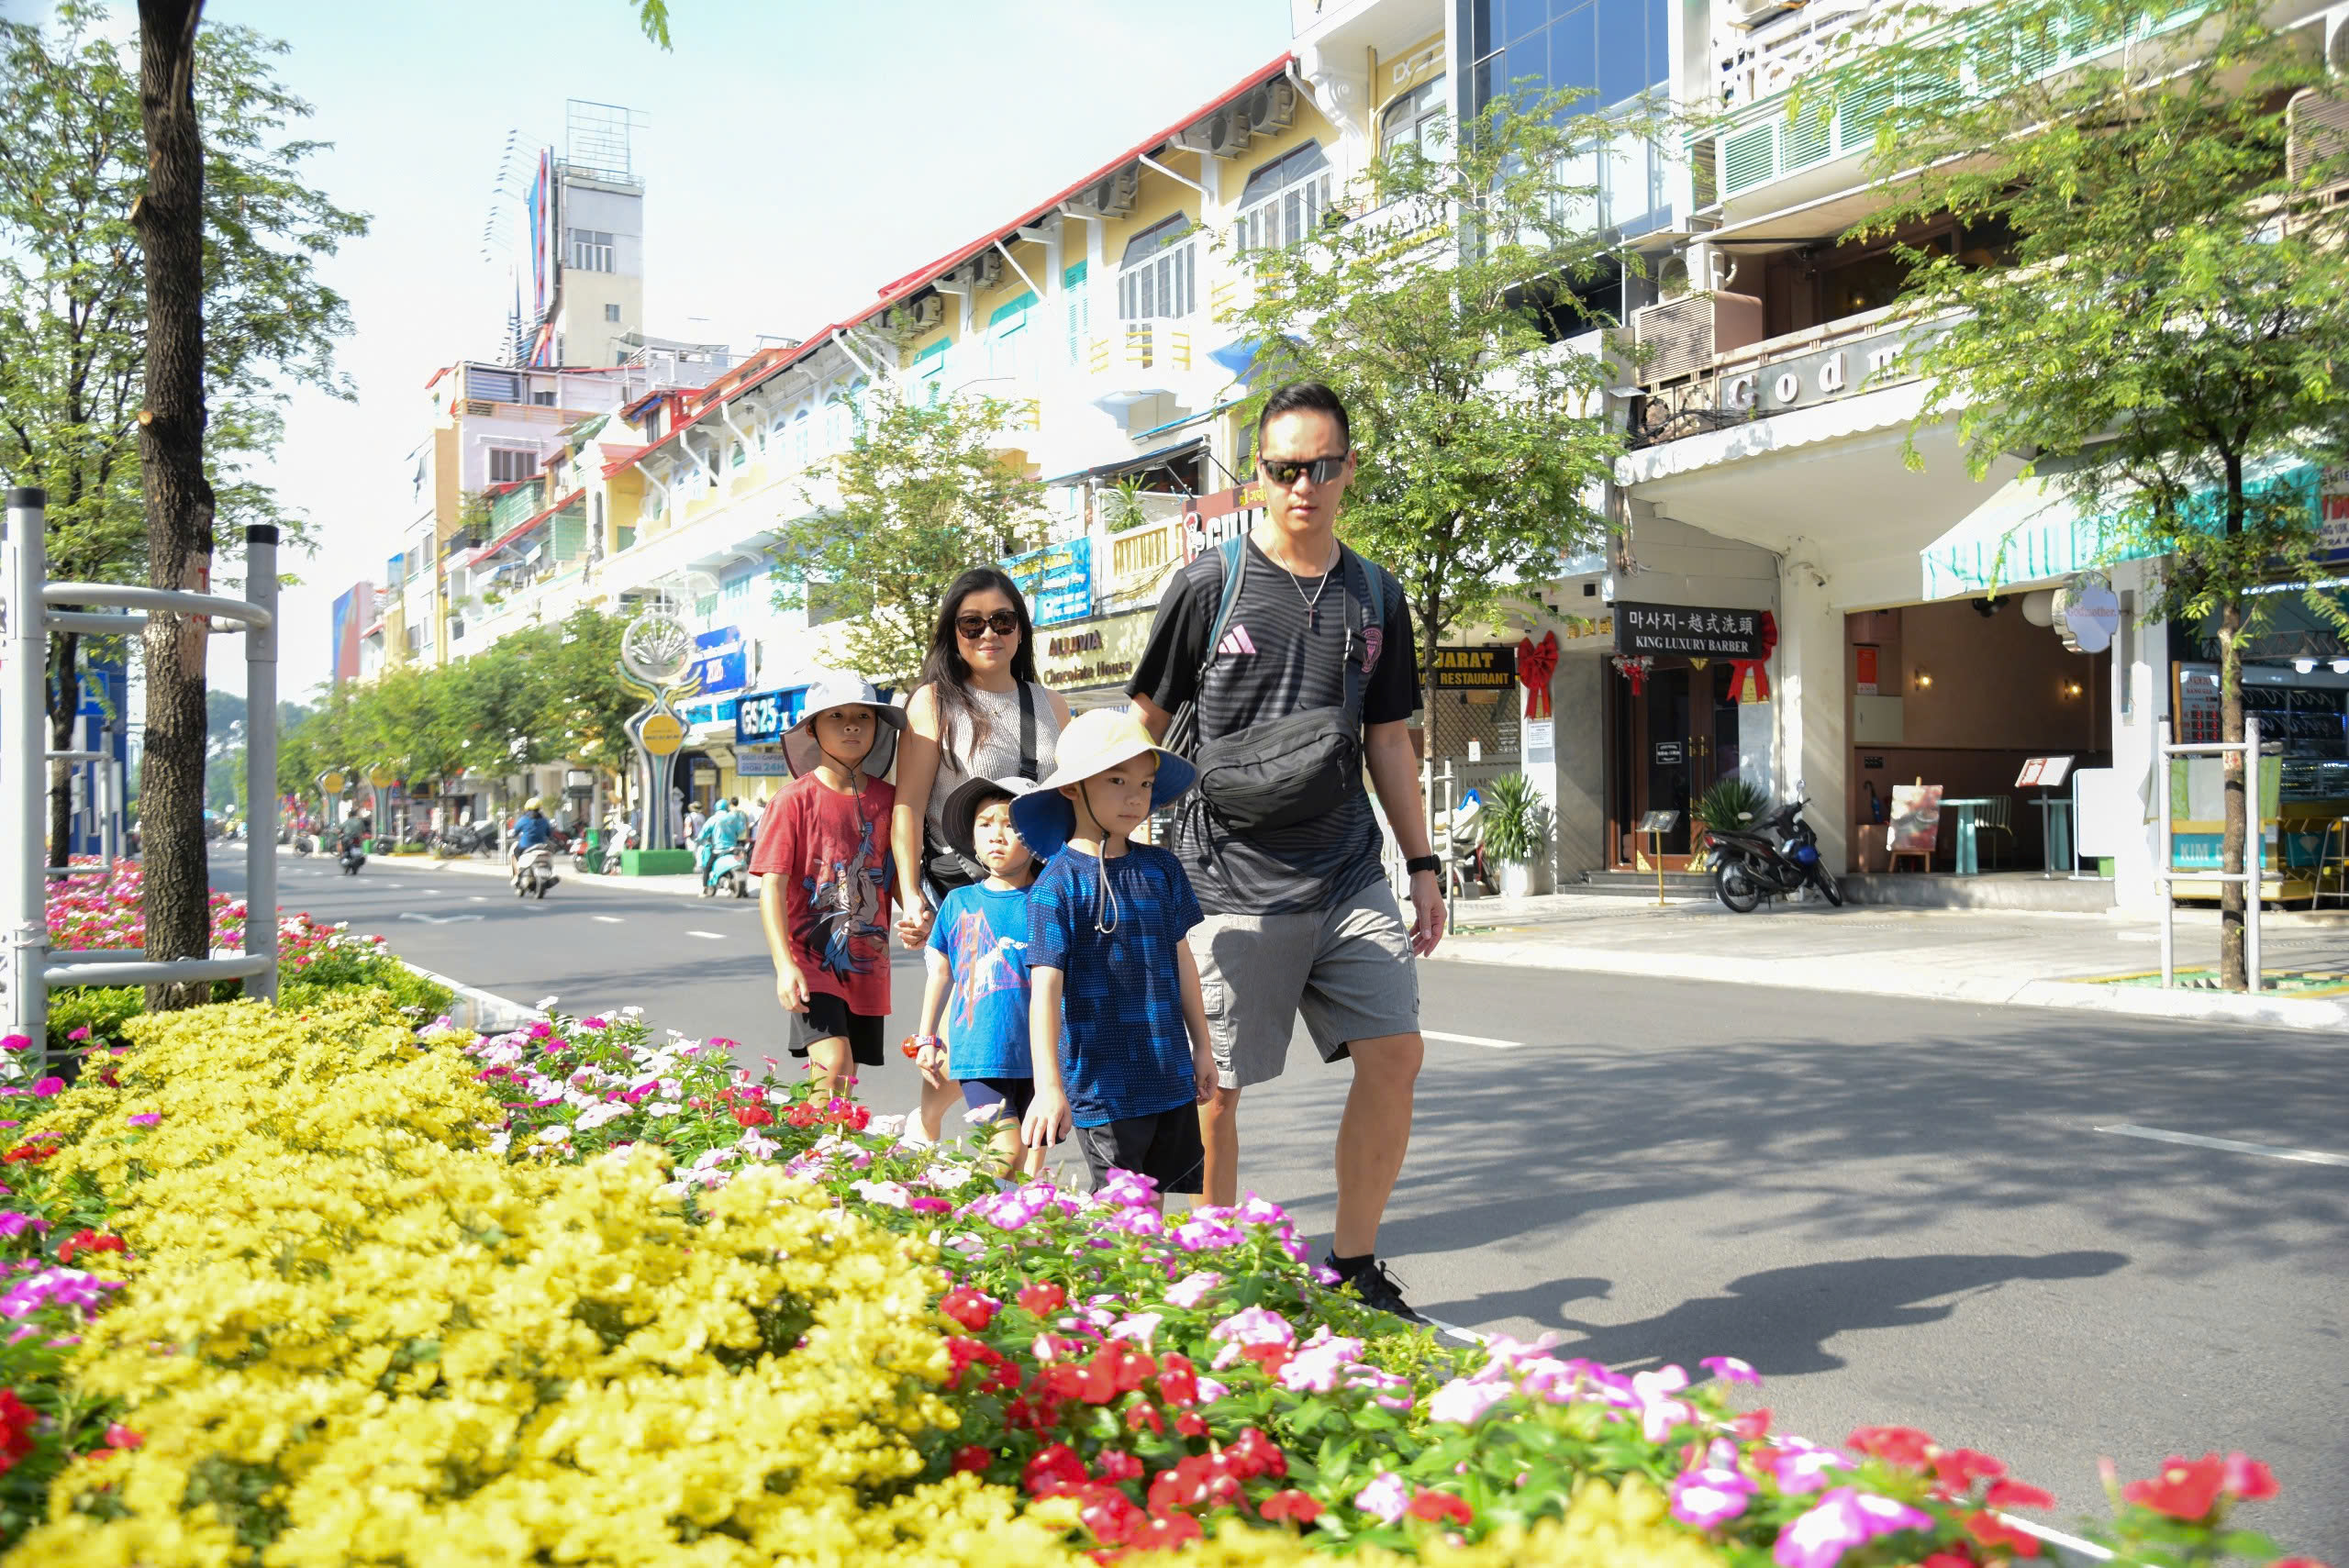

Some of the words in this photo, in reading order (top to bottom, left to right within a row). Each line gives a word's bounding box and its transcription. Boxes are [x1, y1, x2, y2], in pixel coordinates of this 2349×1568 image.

[1049, 629, 1103, 656] ALLUVIA
[1635, 636, 1663, 649] KING
[1664, 637, 1708, 651] LUXURY
[1709, 639, 1749, 652] BARBER
[1043, 665, 1095, 684] Chocolate
[1097, 661, 1132, 677] House
[1440, 673, 1509, 684] RESTAURANT
[740, 697, 778, 736] GS25
[763, 762, 785, 772] 24H
[2180, 843, 2210, 861] KIM
